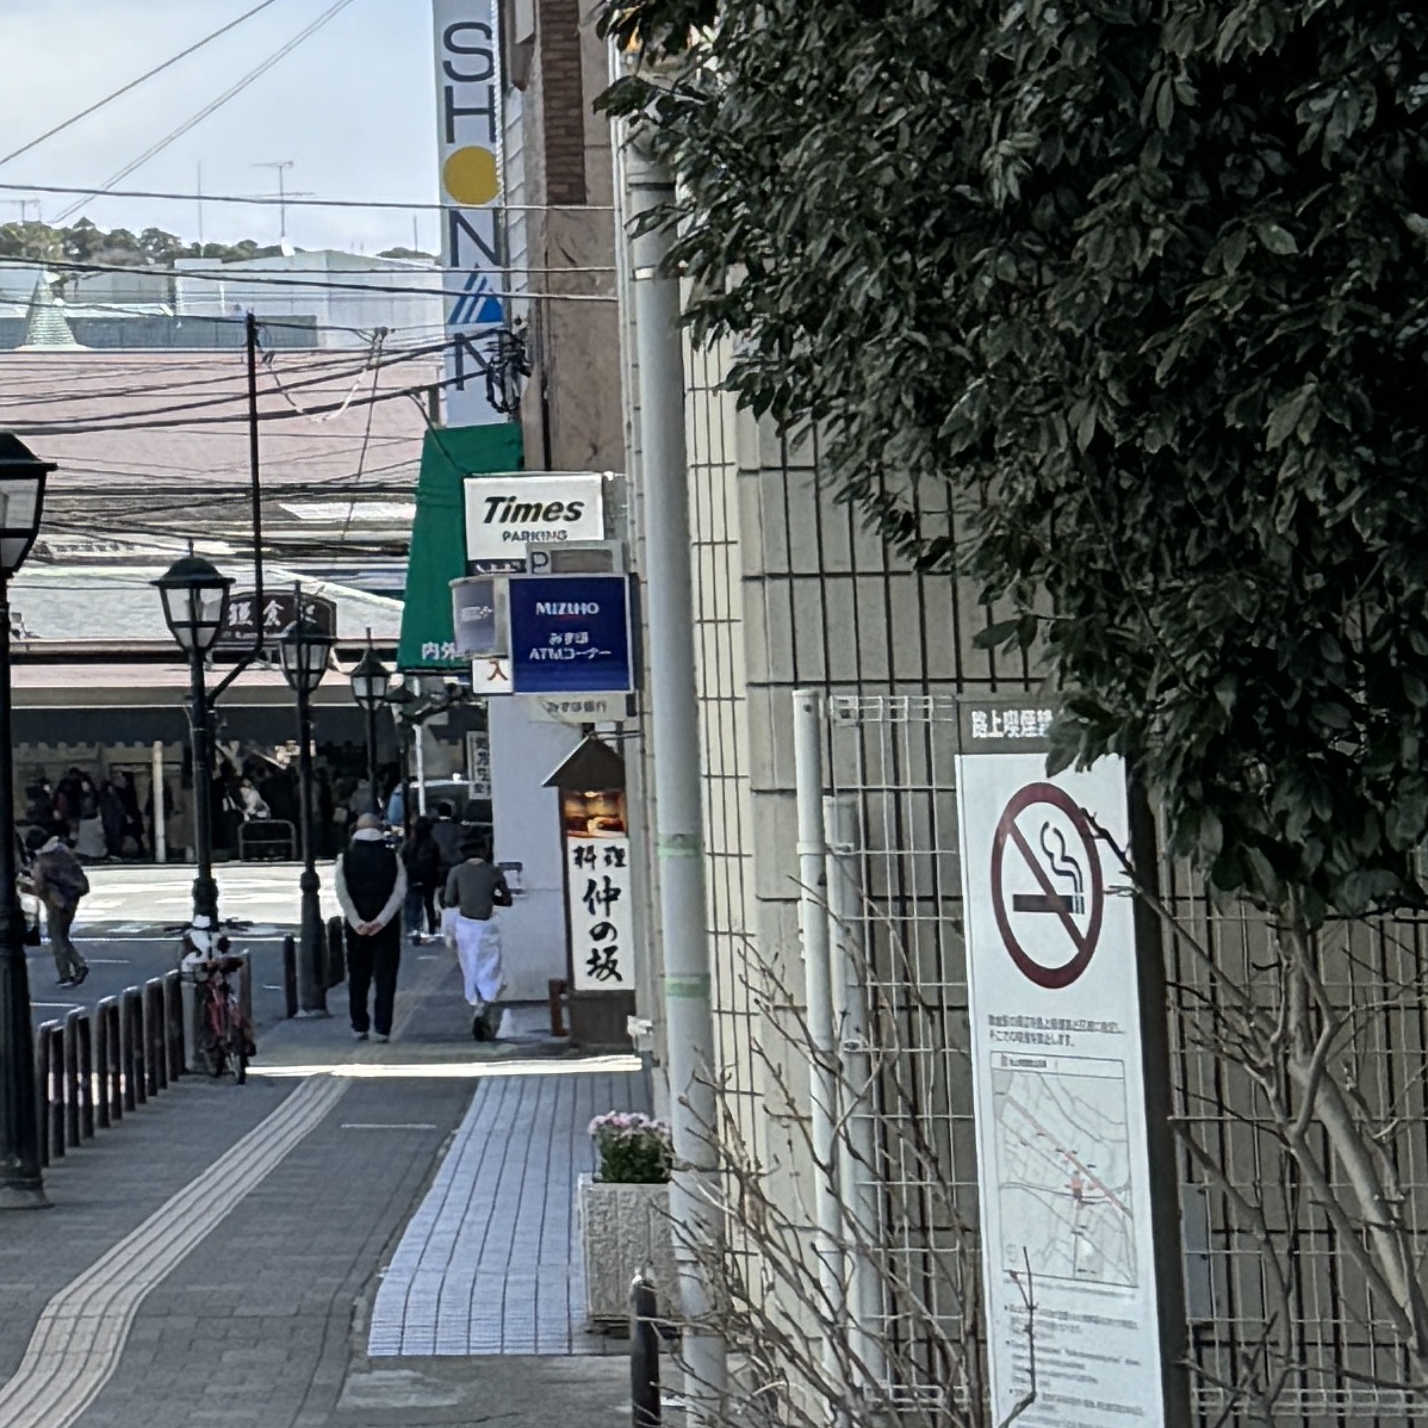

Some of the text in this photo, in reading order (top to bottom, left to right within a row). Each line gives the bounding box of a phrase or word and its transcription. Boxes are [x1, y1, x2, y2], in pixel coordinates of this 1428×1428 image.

[484, 496, 585, 523] Times
[502, 530, 568, 543] PARKING
[531, 551, 549, 573] P
[535, 601, 599, 616] MIZUHO
[549, 631, 589, 645] みずほ
[529, 647, 612, 661] ATMコーナー
[572, 844, 627, 870] 料理
[583, 874, 624, 982] 仲の坂
